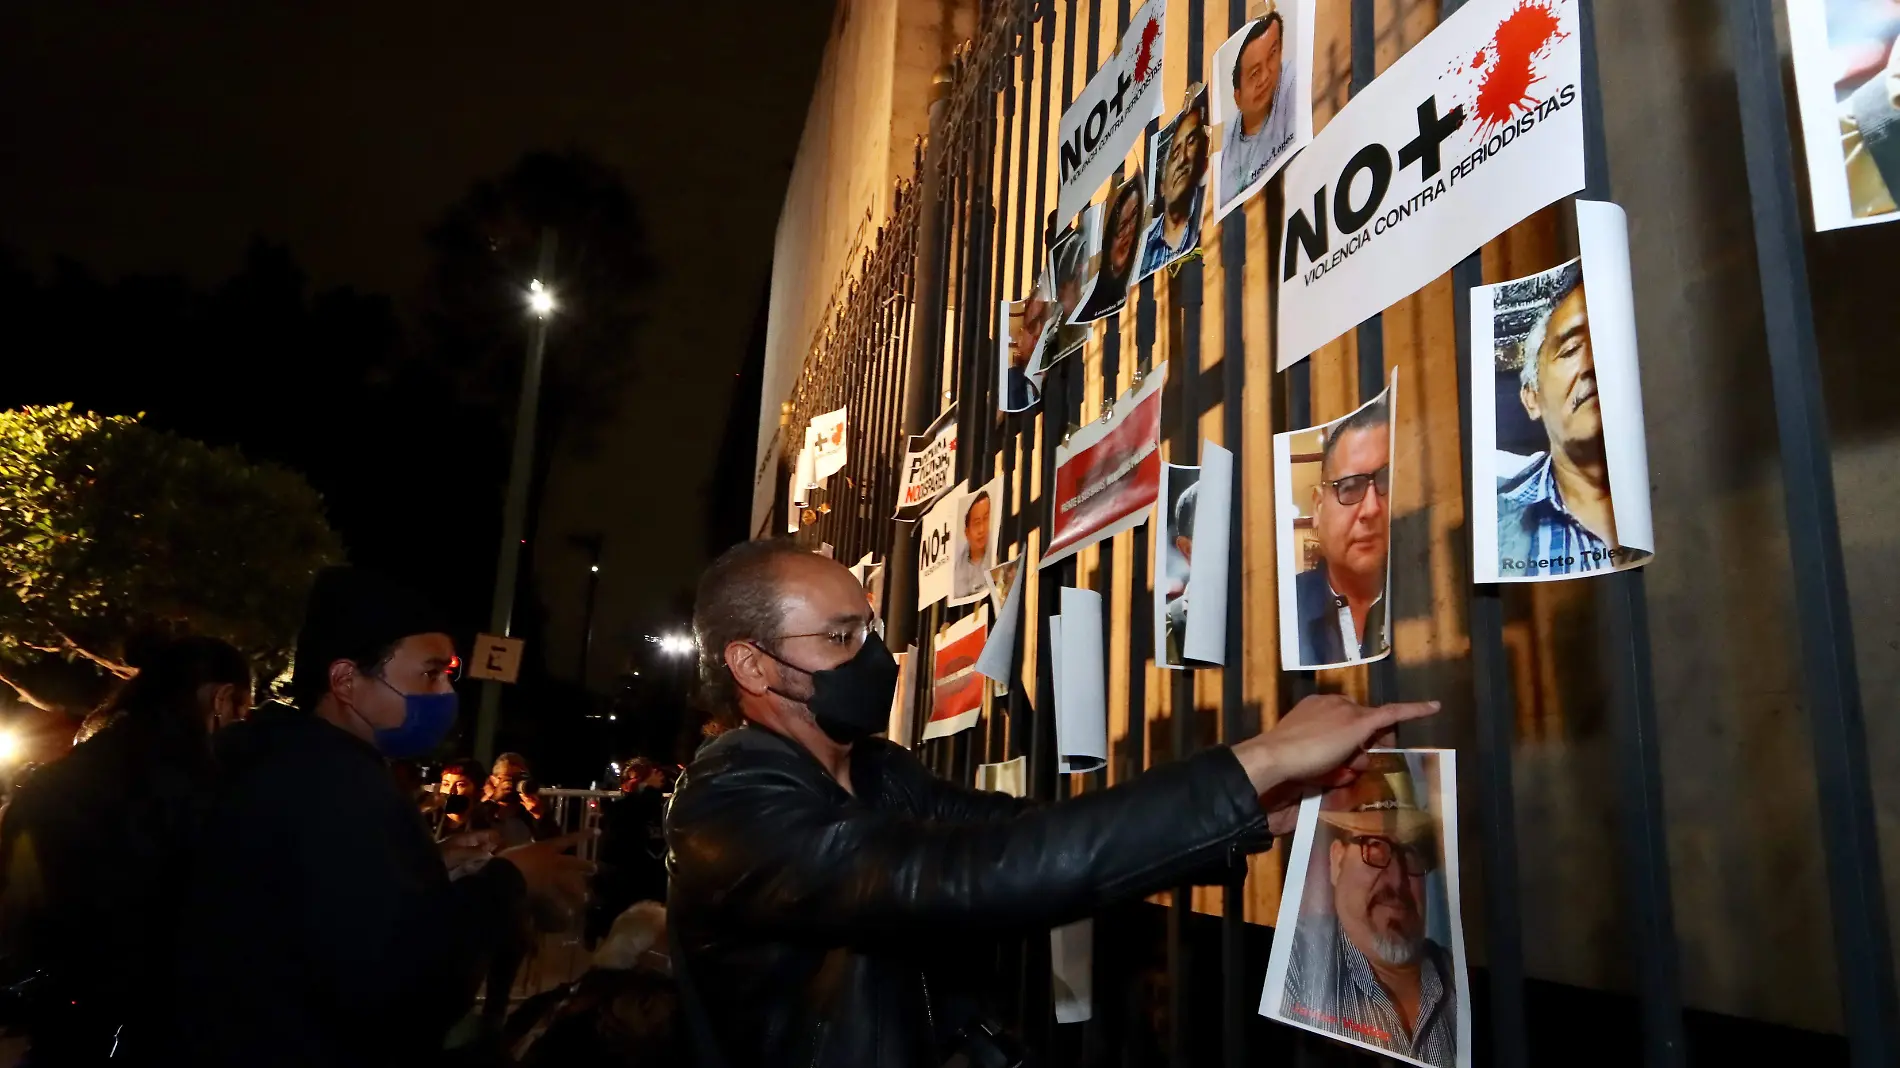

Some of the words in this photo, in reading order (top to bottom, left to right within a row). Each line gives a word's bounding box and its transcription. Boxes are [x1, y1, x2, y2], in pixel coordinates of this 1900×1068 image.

[1061, 70, 1132, 186] NO+
[1284, 94, 1468, 283] NO+
[1304, 228, 1371, 288] VIOLENCIA
[1374, 177, 1447, 237] CONTRA
[1450, 83, 1577, 187] PERIODISTAS
[1502, 555, 1575, 570] Roberto
